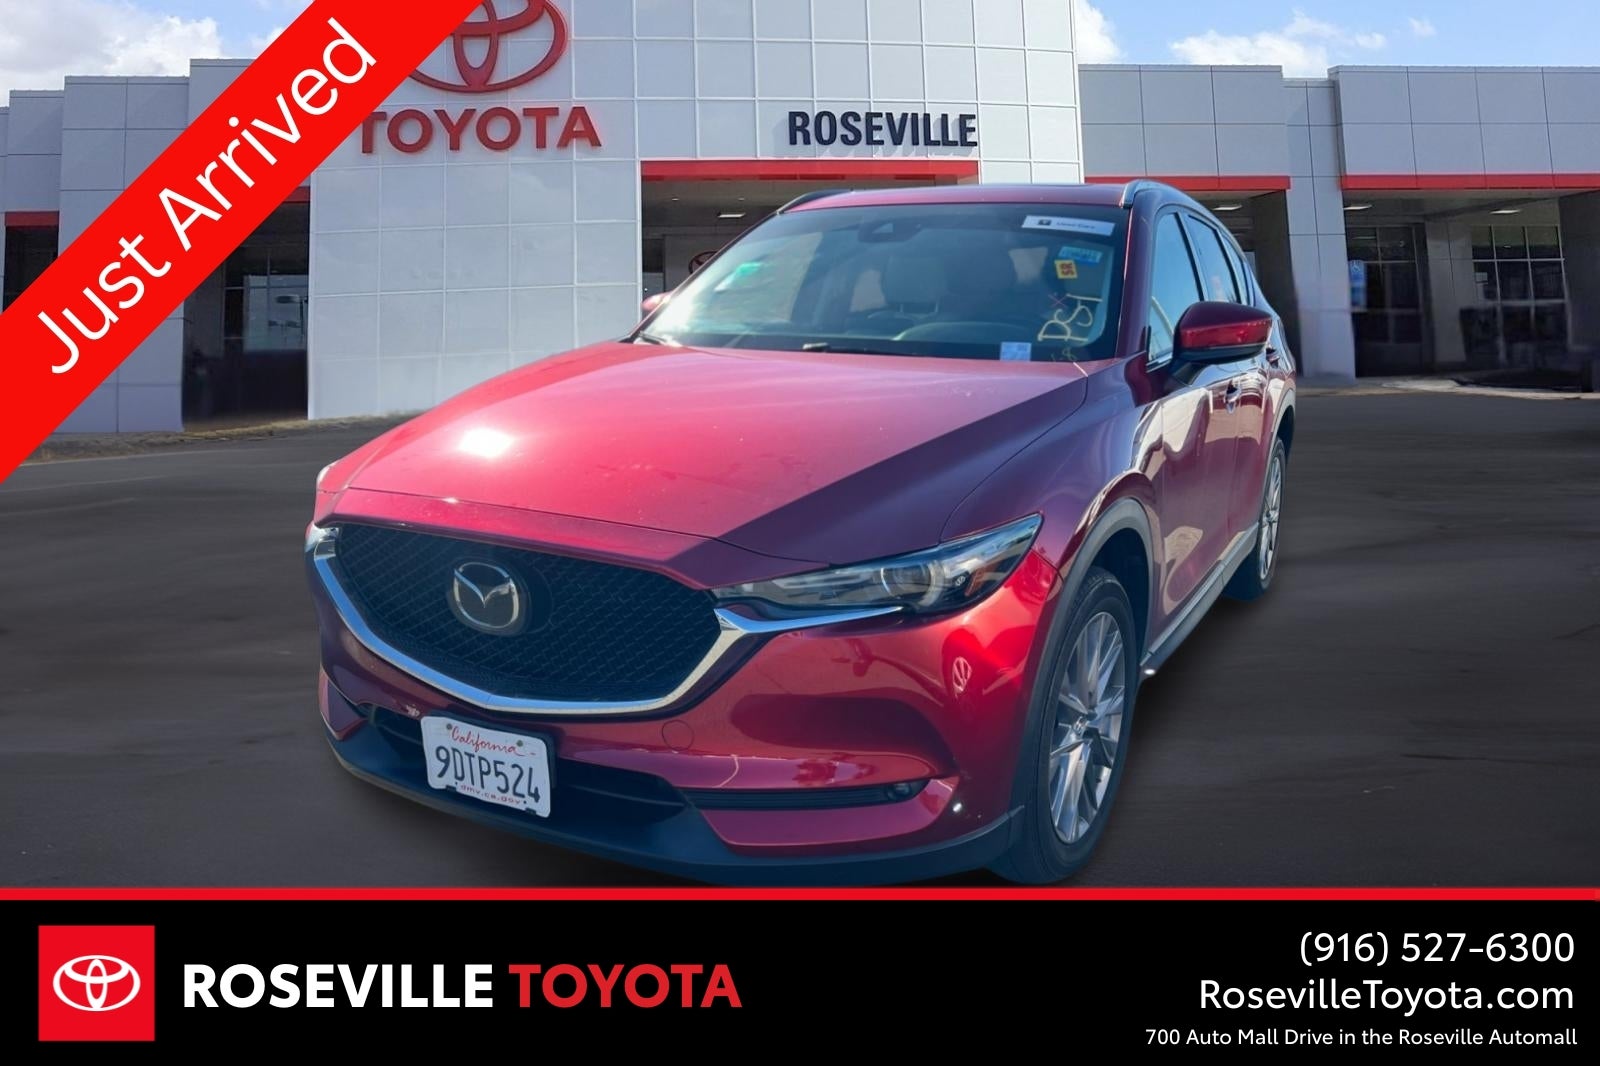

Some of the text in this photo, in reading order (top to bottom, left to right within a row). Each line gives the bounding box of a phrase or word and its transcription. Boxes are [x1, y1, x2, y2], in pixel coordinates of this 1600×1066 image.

[361, 106, 602, 154] TOYOTA
[788, 110, 978, 148] ROSEVILLE
[451, 725, 526, 757] California
[435, 745, 541, 803] 9DTP524
